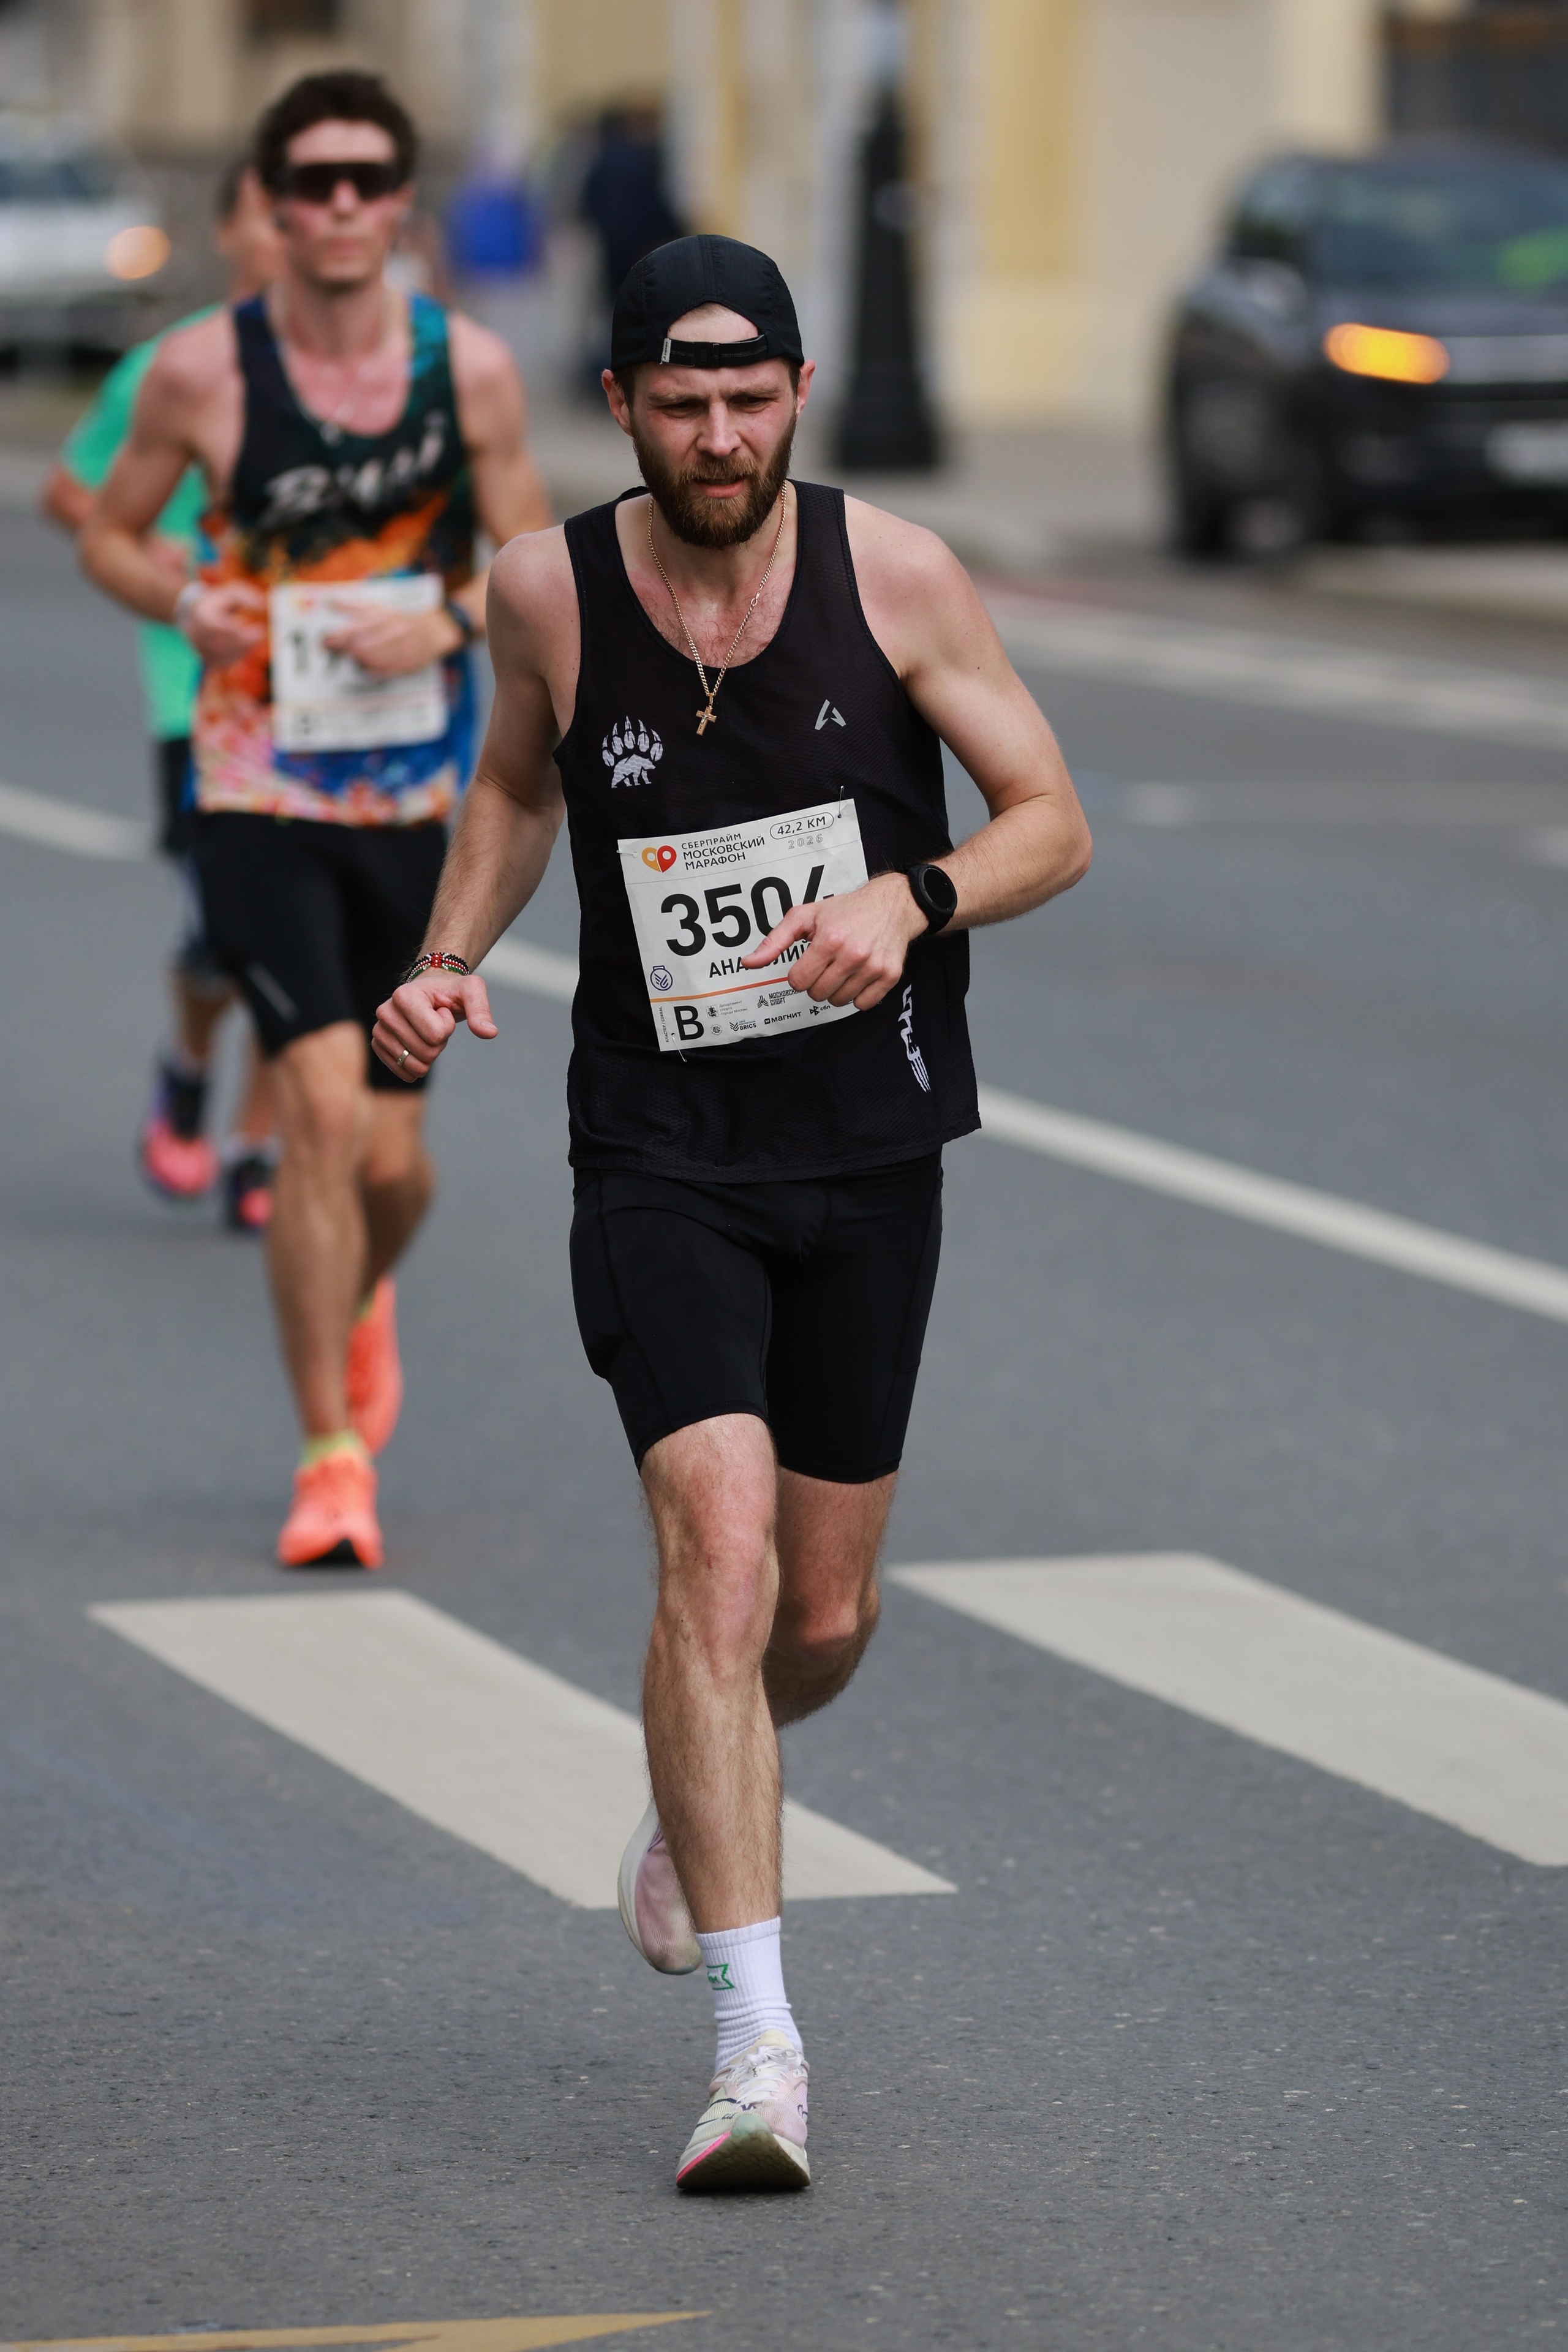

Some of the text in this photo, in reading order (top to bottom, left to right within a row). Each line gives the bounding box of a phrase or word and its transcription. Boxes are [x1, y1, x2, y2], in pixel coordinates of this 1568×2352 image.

[777, 816, 826, 835] 42,2 КМ
[681, 833, 741, 850] СБЕРПРАЙМ
[683, 835, 766, 861] МОСКОВСКИЙ
[788, 833, 823, 850] 2026
[685, 852, 746, 870] МАРАФОН
[768, 989, 802, 1000] МОСКОВСК
[769, 997, 786, 1006] СПОРТ
